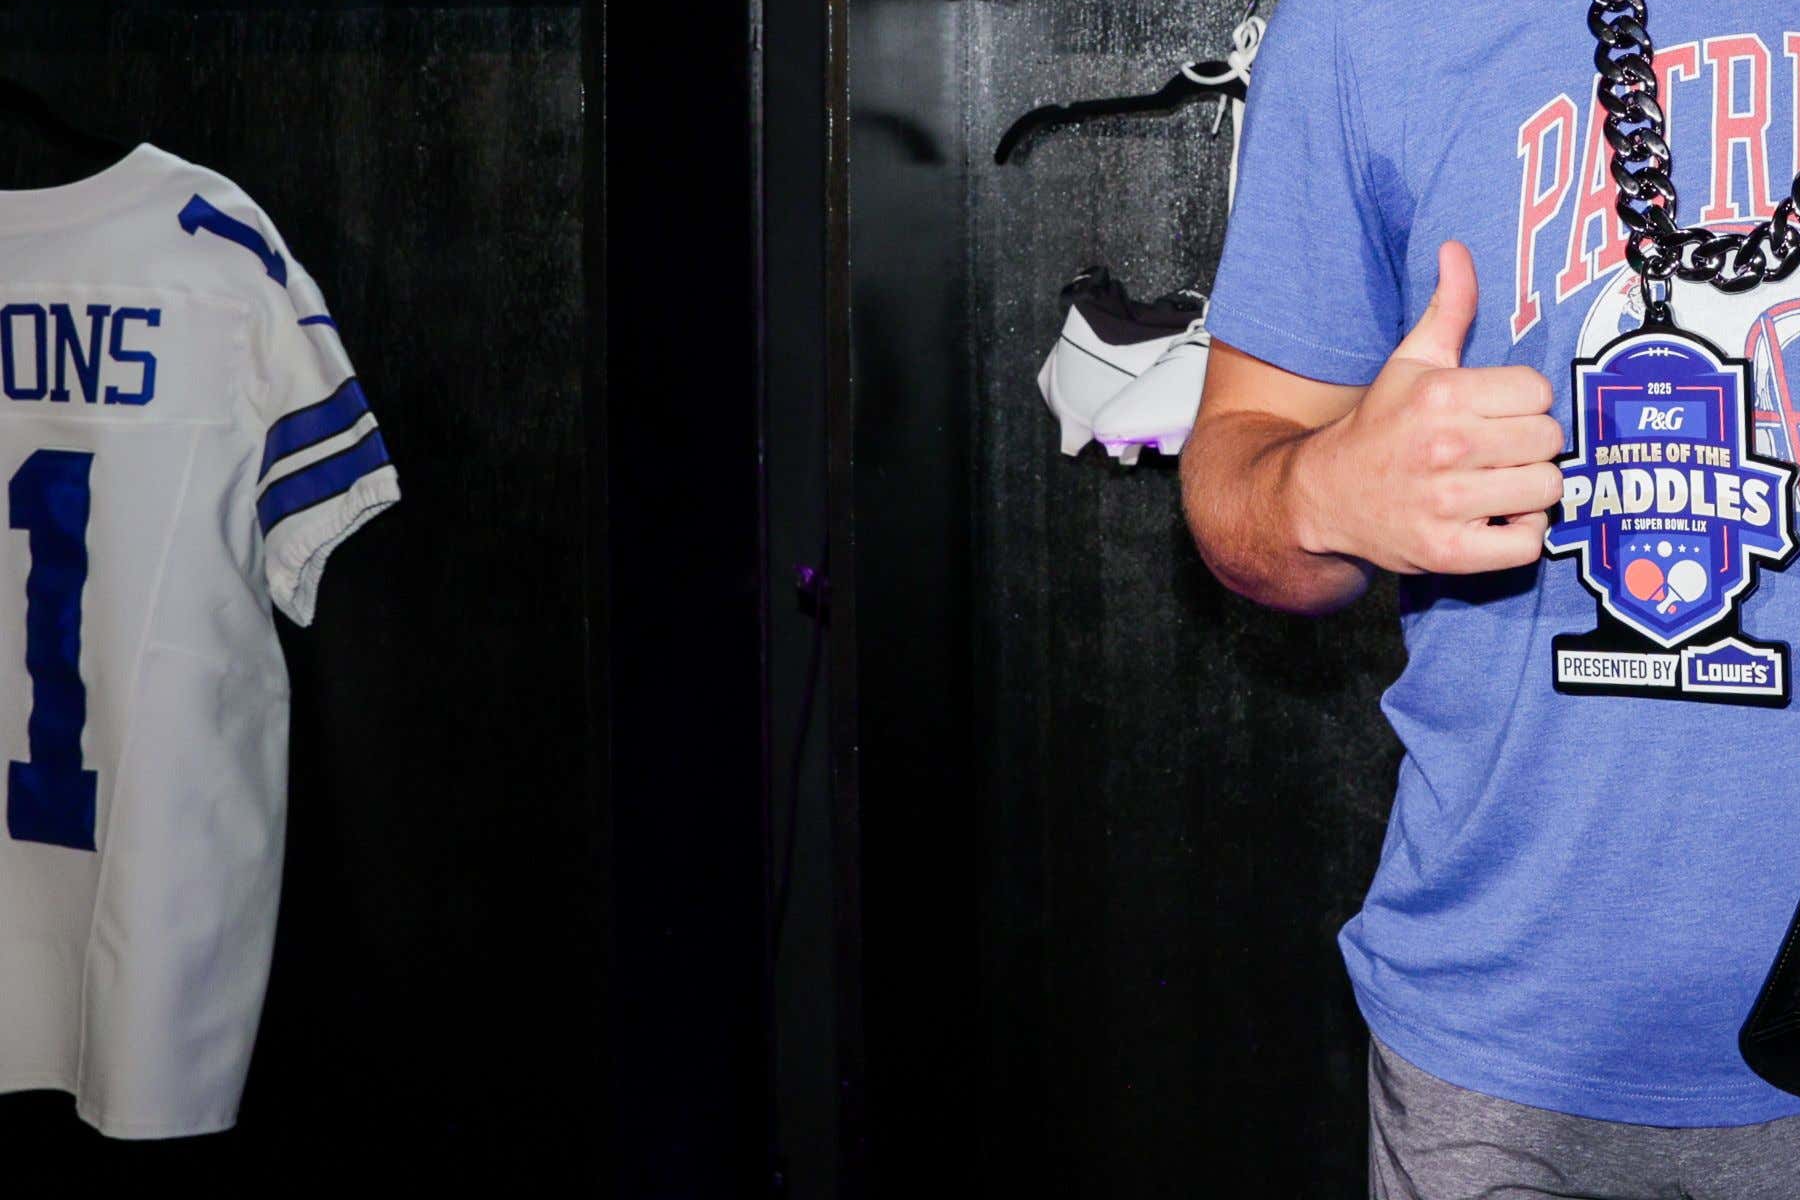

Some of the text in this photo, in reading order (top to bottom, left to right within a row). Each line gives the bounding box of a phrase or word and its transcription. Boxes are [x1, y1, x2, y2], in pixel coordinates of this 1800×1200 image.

[1648, 382, 1672, 395] 2025
[1638, 406, 1684, 431] P&G
[1596, 443, 1731, 468] BATTLE OF THE
[1561, 467, 1772, 527] PADDLES
[1621, 519, 1707, 532] AT SUPER BOWL LIX
[1563, 657, 1673, 680] PRESENTED BY
[1696, 659, 1769, 684] LOWE'S
